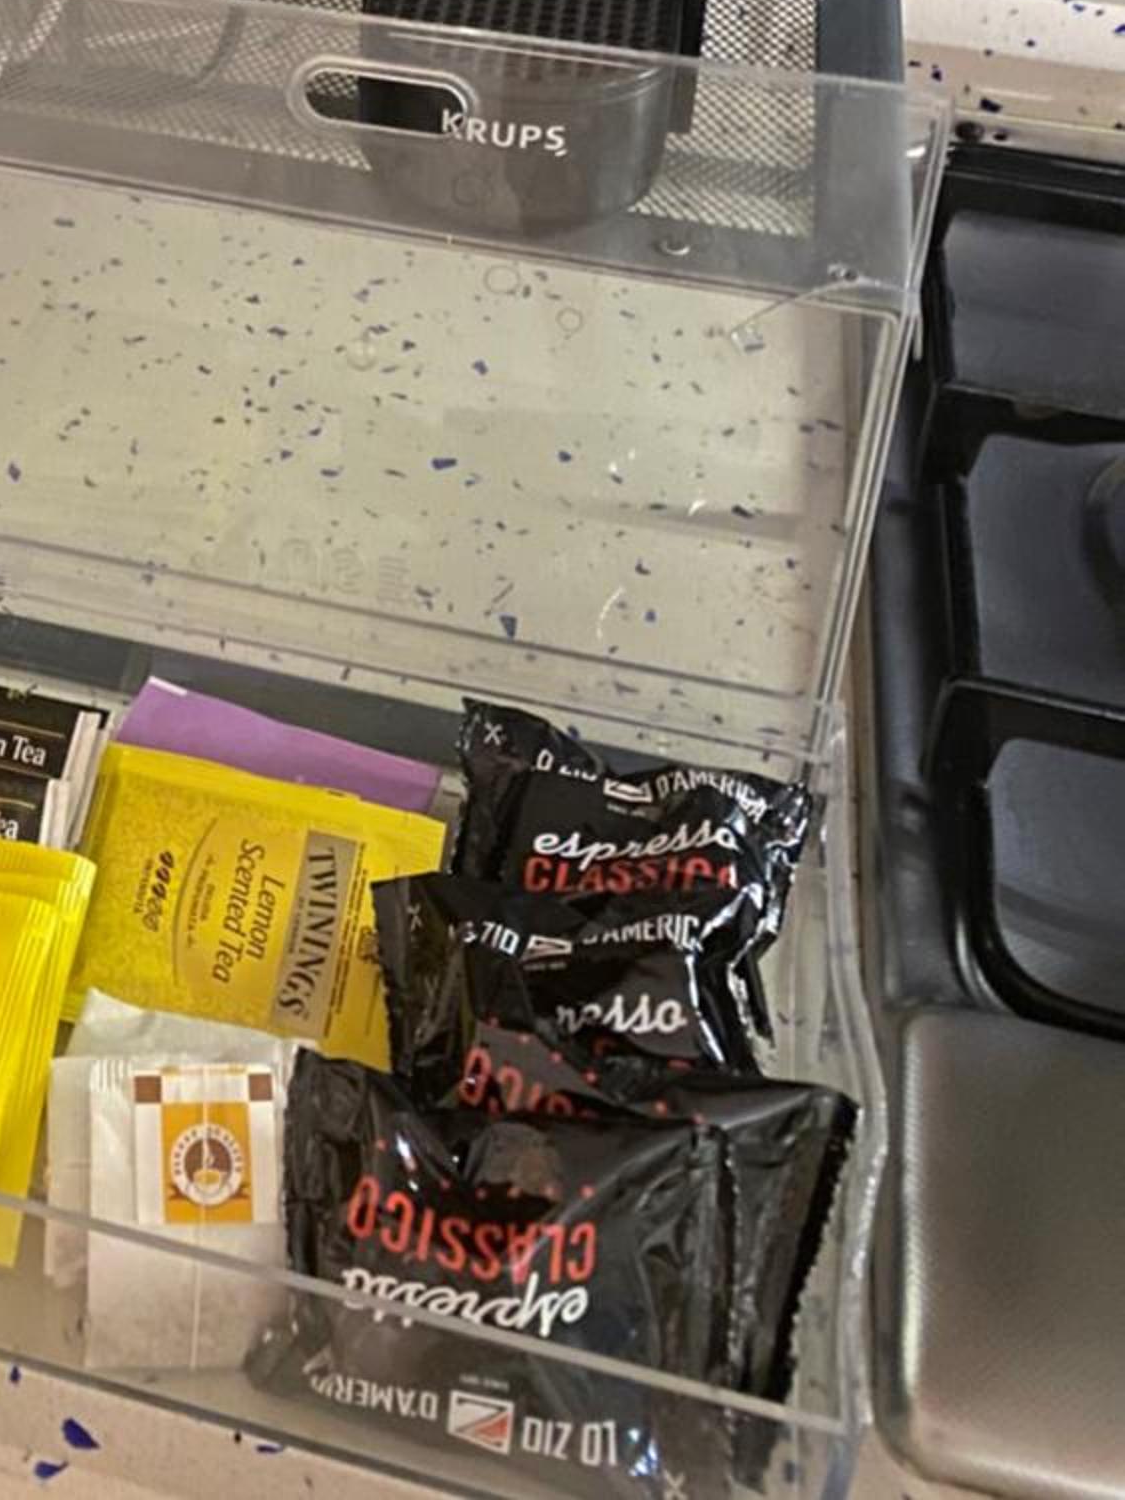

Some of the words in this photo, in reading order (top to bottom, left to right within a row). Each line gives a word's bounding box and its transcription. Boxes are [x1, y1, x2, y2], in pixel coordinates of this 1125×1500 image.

[441, 108, 568, 156] KRUPS
[11, 734, 47, 768] Tea
[532, 819, 743, 872] espresso
[222, 838, 266, 940] Scented
[245, 874, 286, 961] Lemon
[278, 846, 339, 1019] TWININGS
[211, 939, 243, 985] Tea
[346, 1174, 596, 1284] CLASSICO
[340, 1268, 590, 1338] espresso
[522, 1416, 572, 1460] ZIO
[580, 1420, 618, 1467] LO
